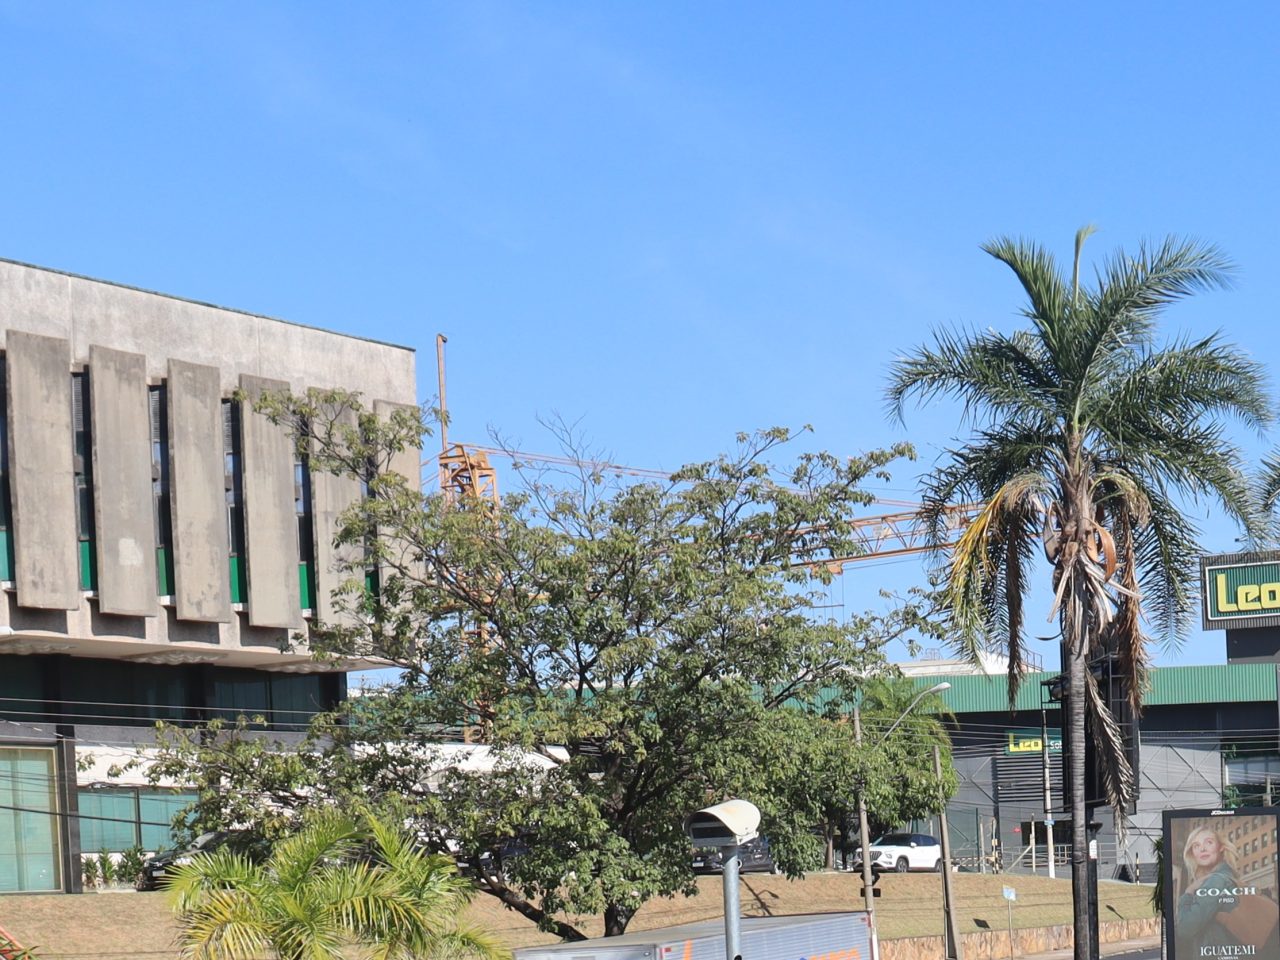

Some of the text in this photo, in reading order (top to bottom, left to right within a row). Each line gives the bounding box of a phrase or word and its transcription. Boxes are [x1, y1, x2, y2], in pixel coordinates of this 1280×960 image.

[1008, 733, 1043, 752] Leo
[1195, 886, 1257, 897] COACH
[1200, 944, 1256, 957] IGUATEMI
